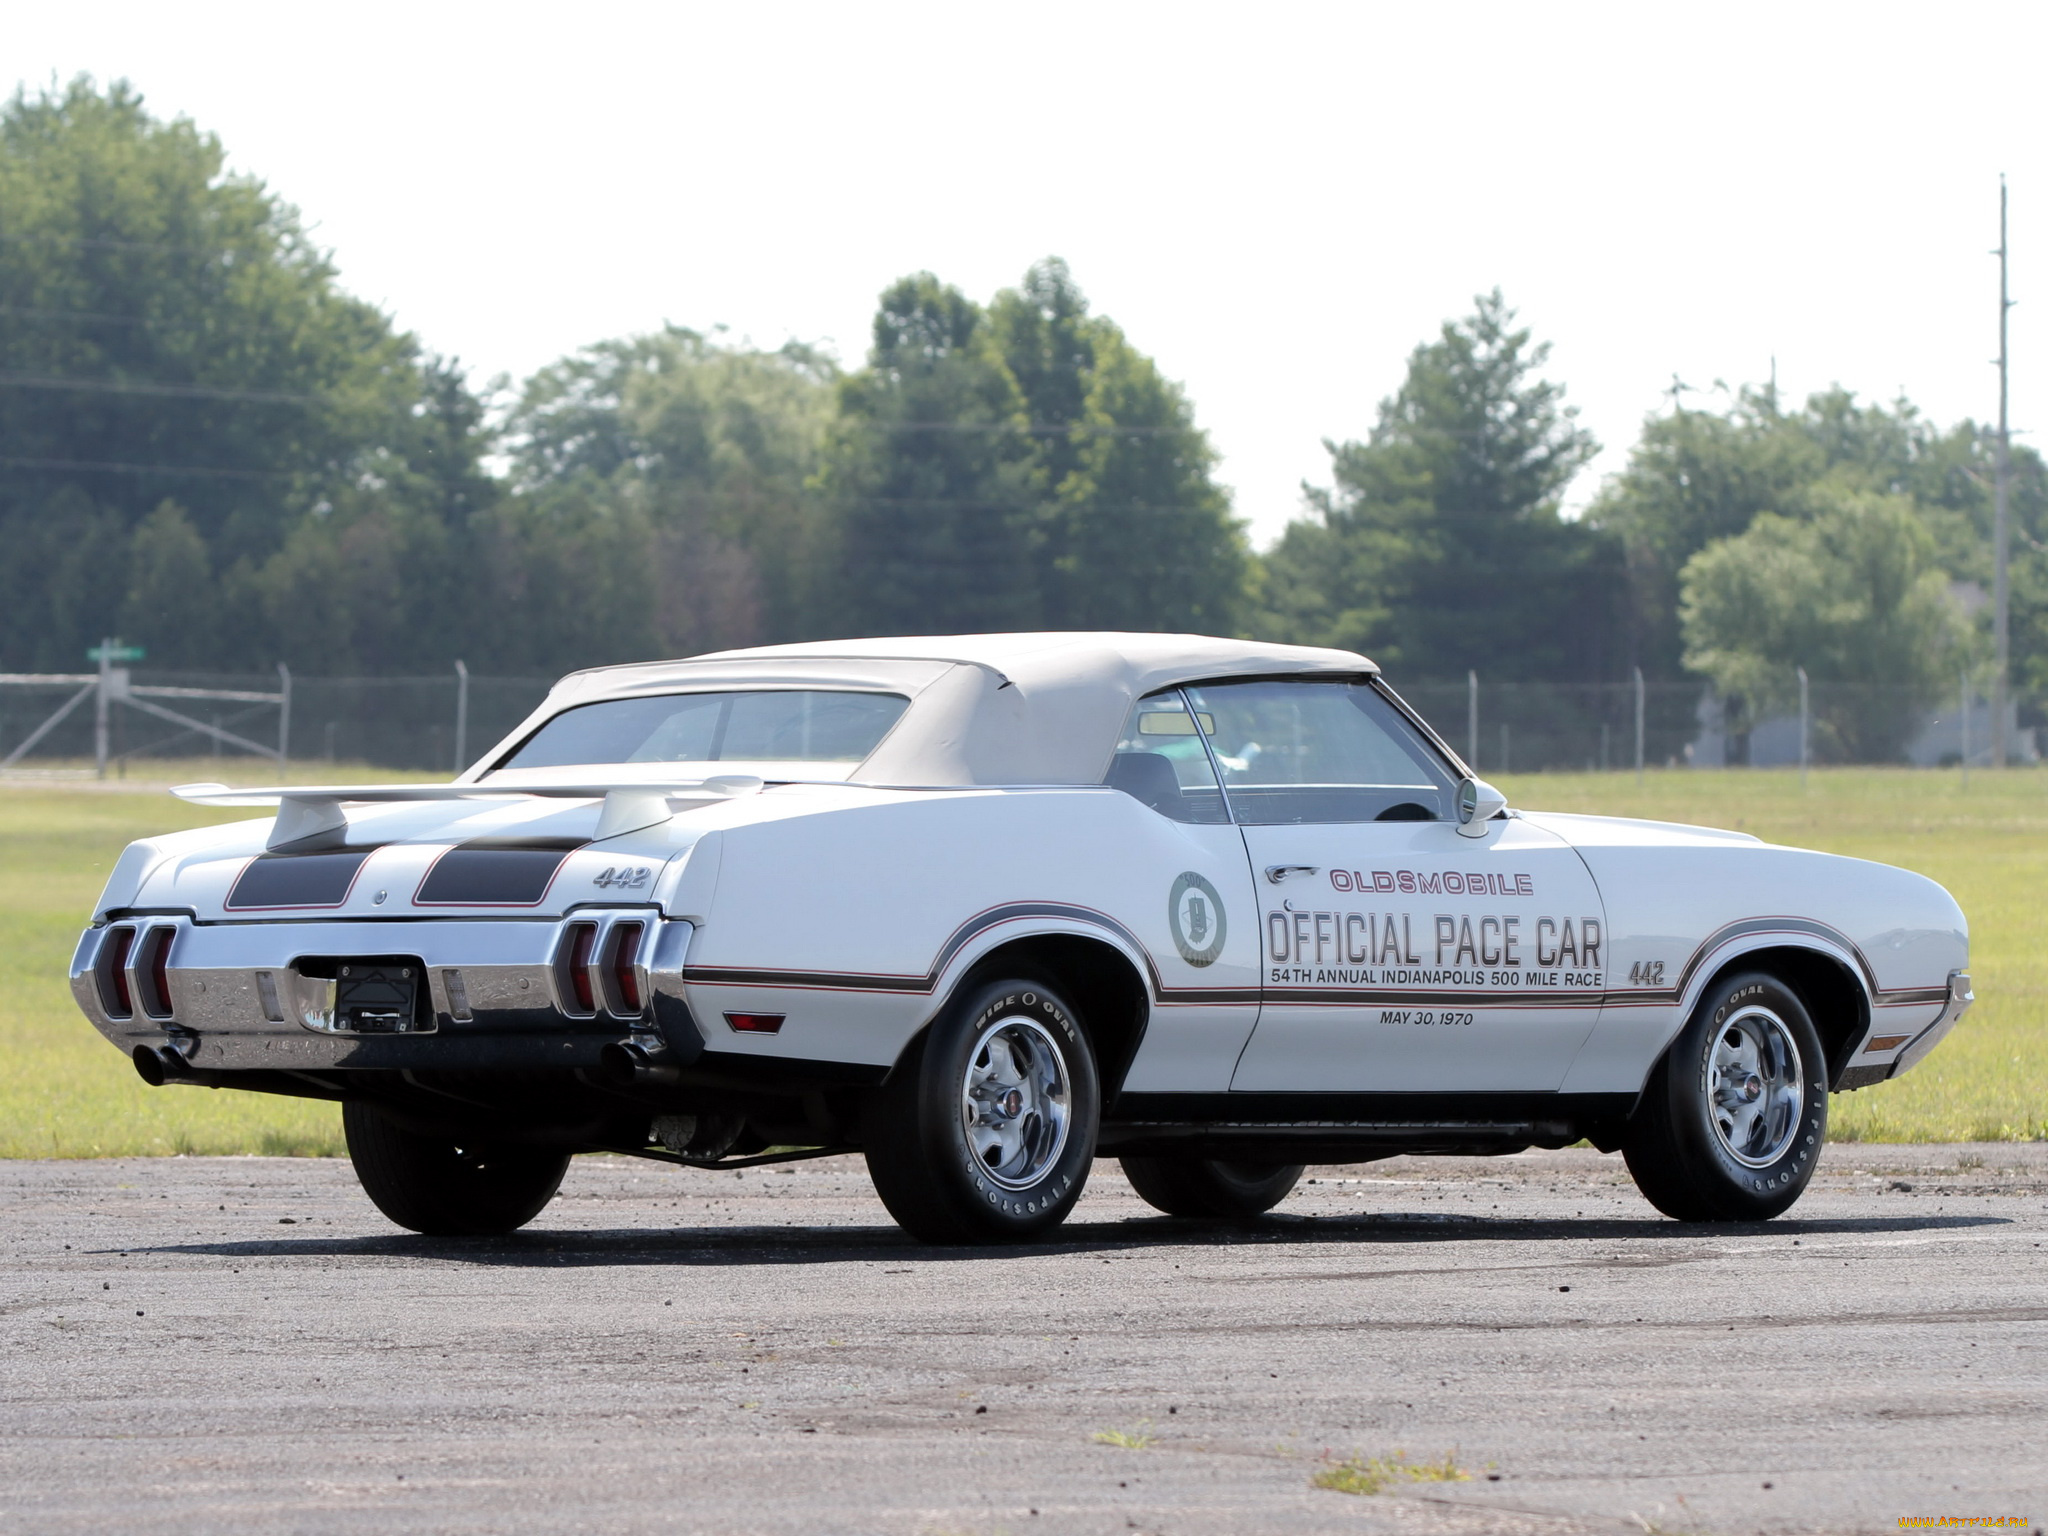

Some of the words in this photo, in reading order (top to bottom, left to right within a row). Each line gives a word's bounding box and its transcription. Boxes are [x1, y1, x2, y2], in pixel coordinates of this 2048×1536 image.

[593, 867, 651, 889] 442
[1329, 869, 1534, 896] OLDSMOBILE
[1267, 910, 1421, 967] OFFICIAL
[1434, 914, 1521, 968] PACE
[1536, 916, 1602, 970] CAR
[1316, 969, 1377, 984] ANNUAL
[1381, 970, 1485, 985] INDIANAPOLIS
[1491, 971, 1520, 986] 500
[1525, 972, 1558, 986] MILE
[1564, 972, 1602, 987] RACE
[1628, 960, 1666, 986] 442
[1729, 985, 1764, 1004] OVAL
[975, 995, 1016, 1030] WIDE
[1042, 1001, 1076, 1043] OVAL
[1379, 1011, 1411, 1025] MAY
[1414, 1011, 1435, 1026] 30,
[1439, 1012, 1474, 1026] 1970
